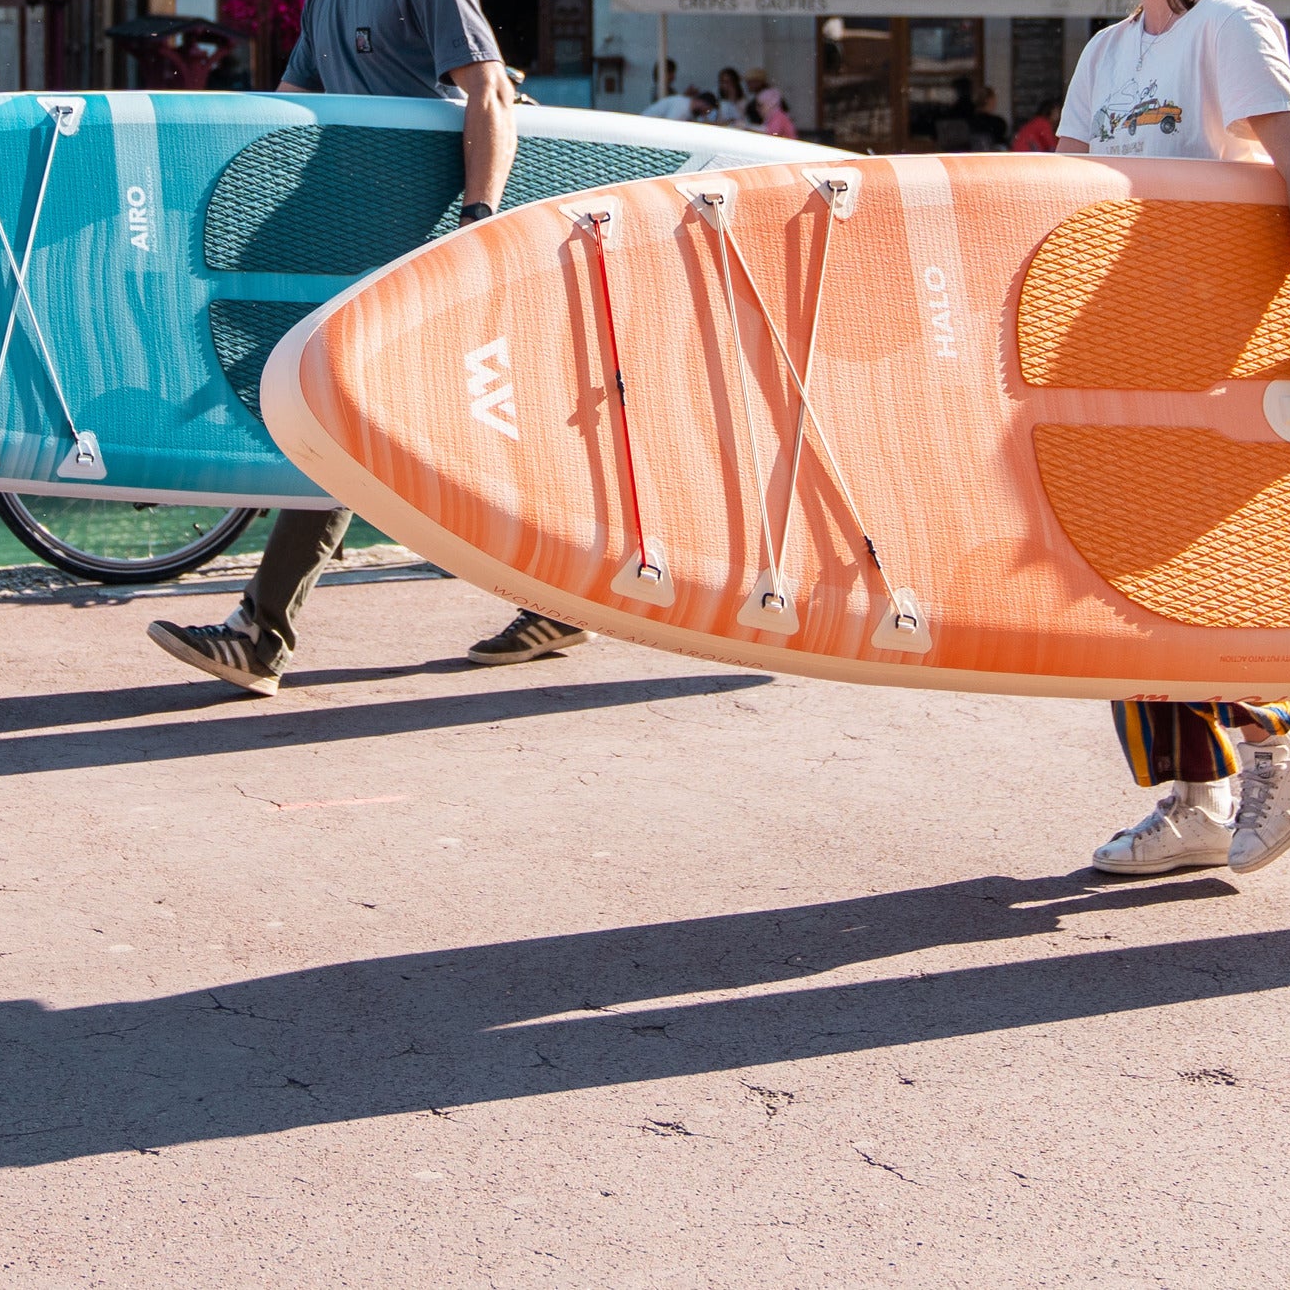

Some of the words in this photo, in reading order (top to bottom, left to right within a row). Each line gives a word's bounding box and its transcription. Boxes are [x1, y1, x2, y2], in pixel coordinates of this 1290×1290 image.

[126, 186, 150, 252] AIRO
[924, 265, 958, 359] HALO
[493, 584, 589, 629] WONDER
[596, 625, 616, 636] IS
